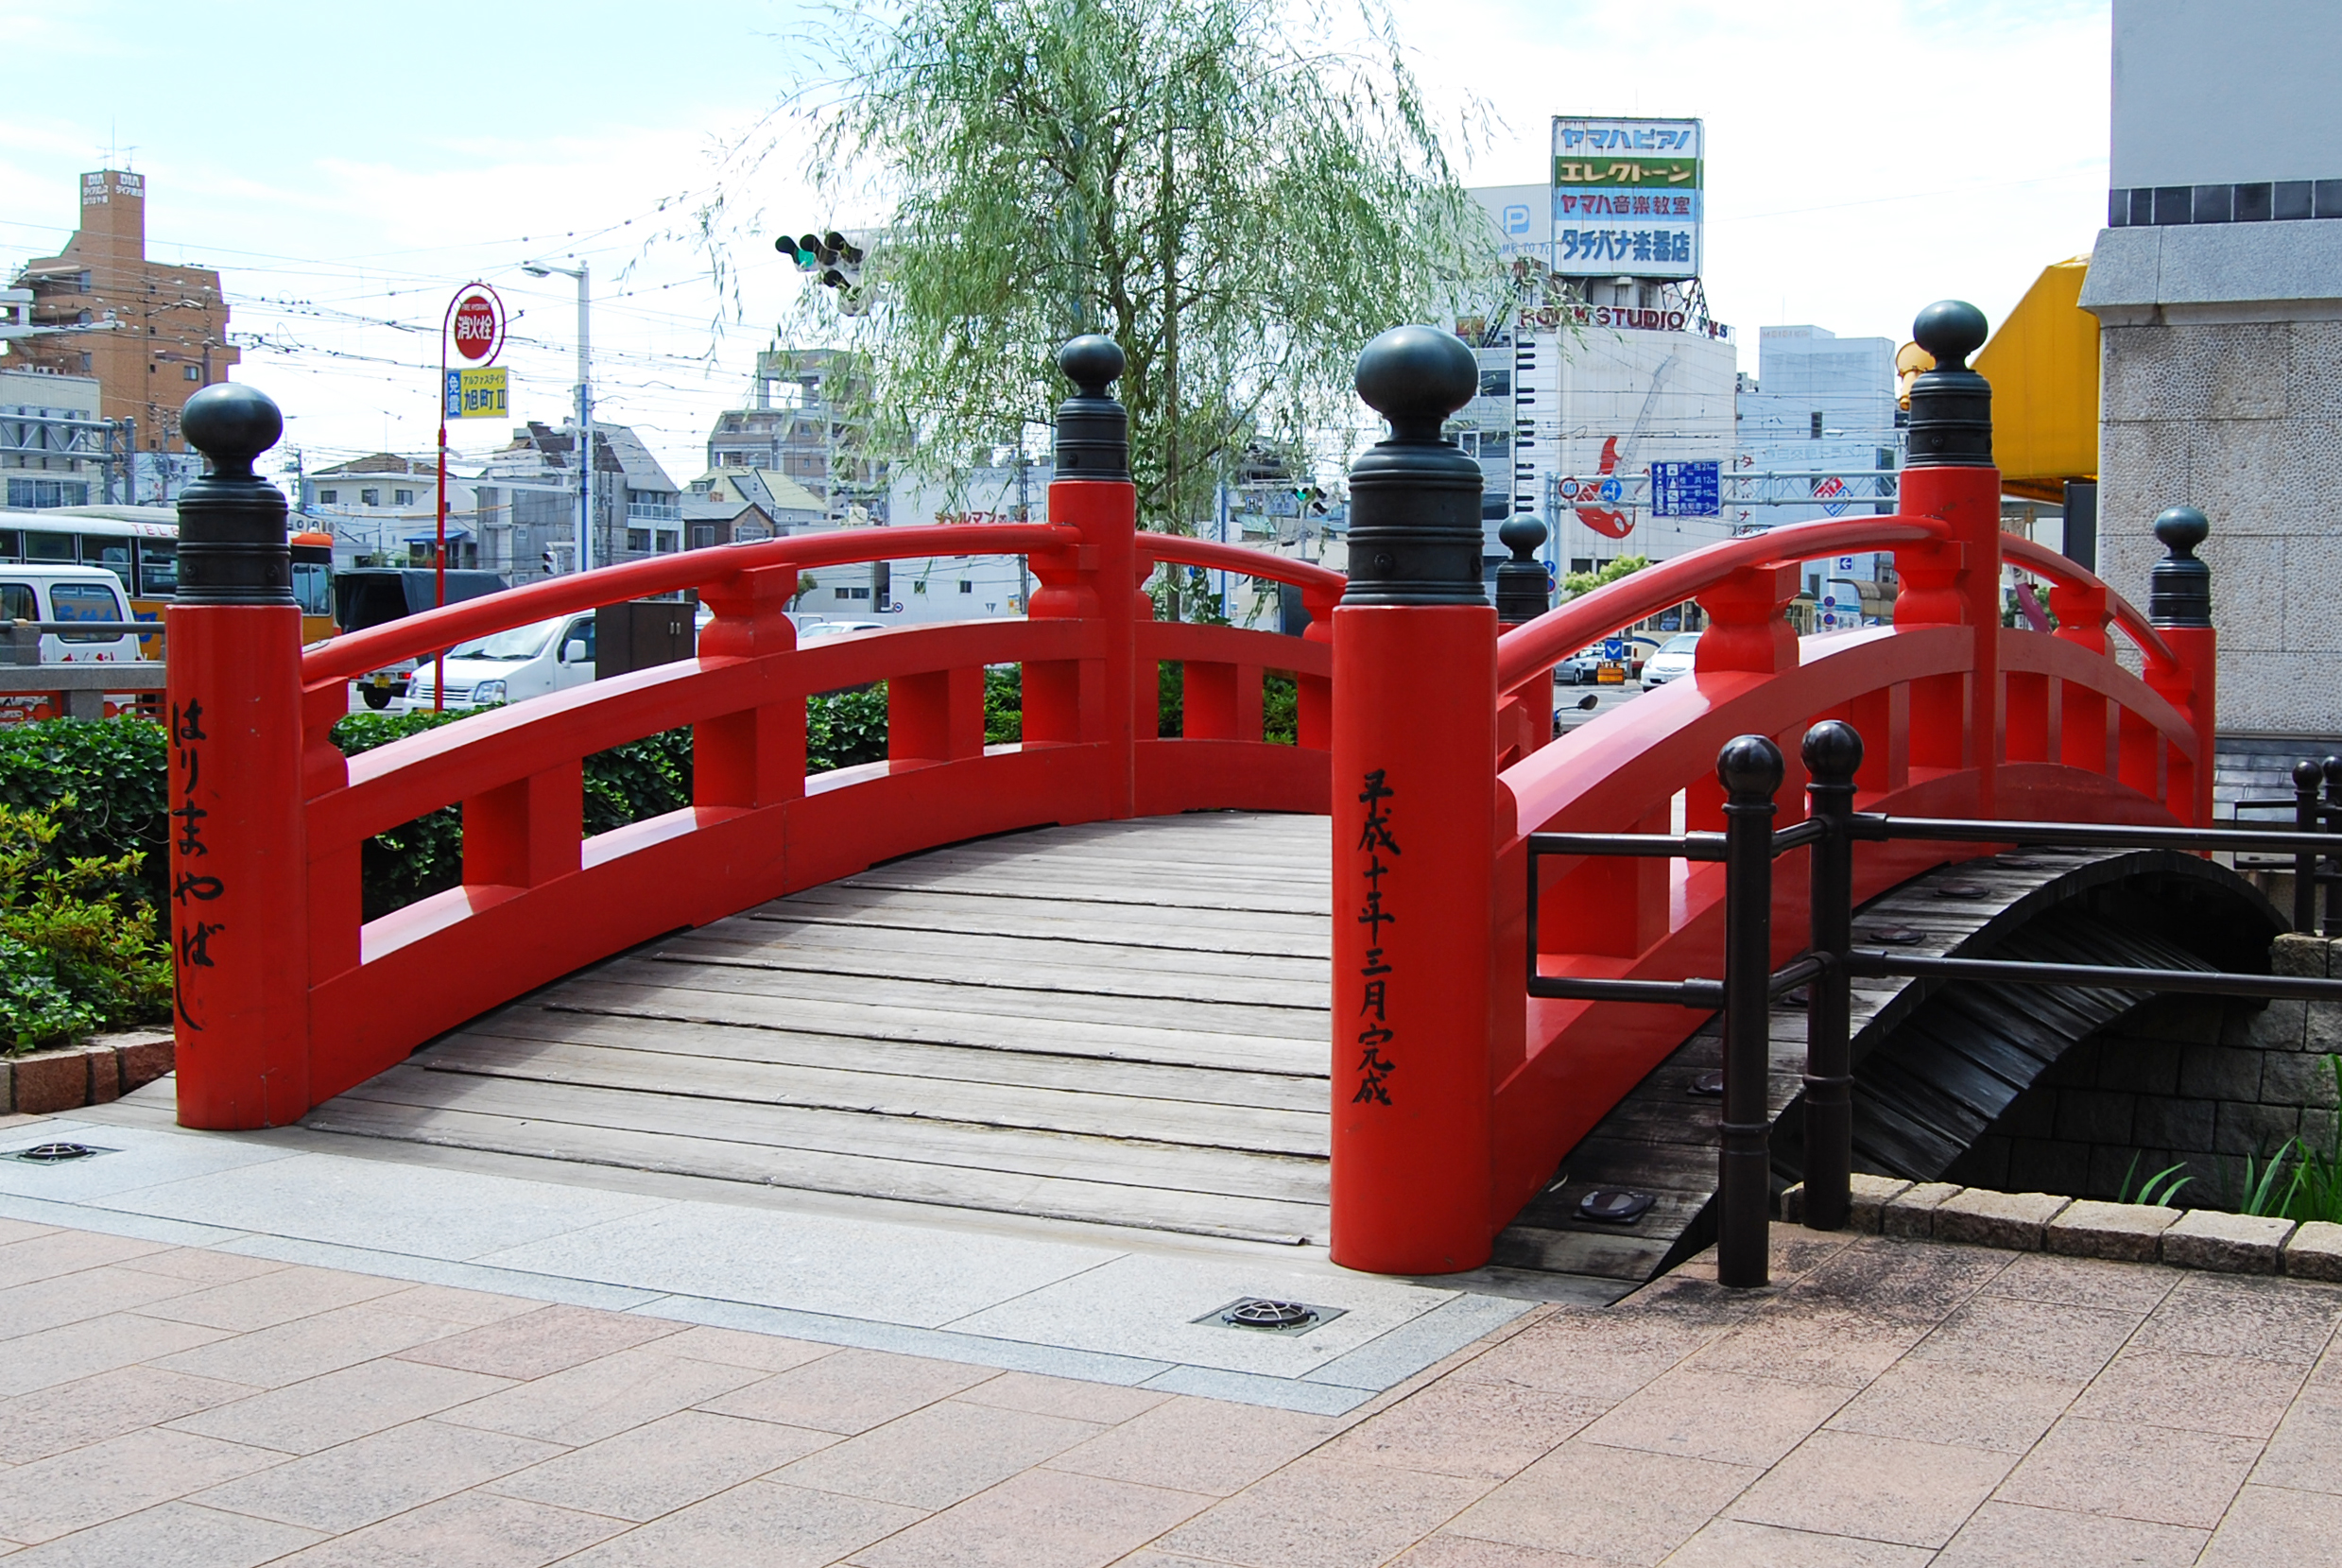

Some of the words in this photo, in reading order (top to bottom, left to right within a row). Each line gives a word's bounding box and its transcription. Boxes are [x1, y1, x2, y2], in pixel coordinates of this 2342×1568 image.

[1561, 128, 1691, 149] ヤマハピアノ
[1560, 163, 1691, 182] エレクトーン
[1560, 195, 1691, 215] ヤマハ音楽教室
[1561, 230, 1691, 262] タチバナ楽器店
[457, 315, 493, 340] 消火栓
[1595, 306, 1686, 331] STUDIO
[171, 697, 225, 1031] はりまやばし
[1352, 768, 1402, 1106] 平成十年三月完成
